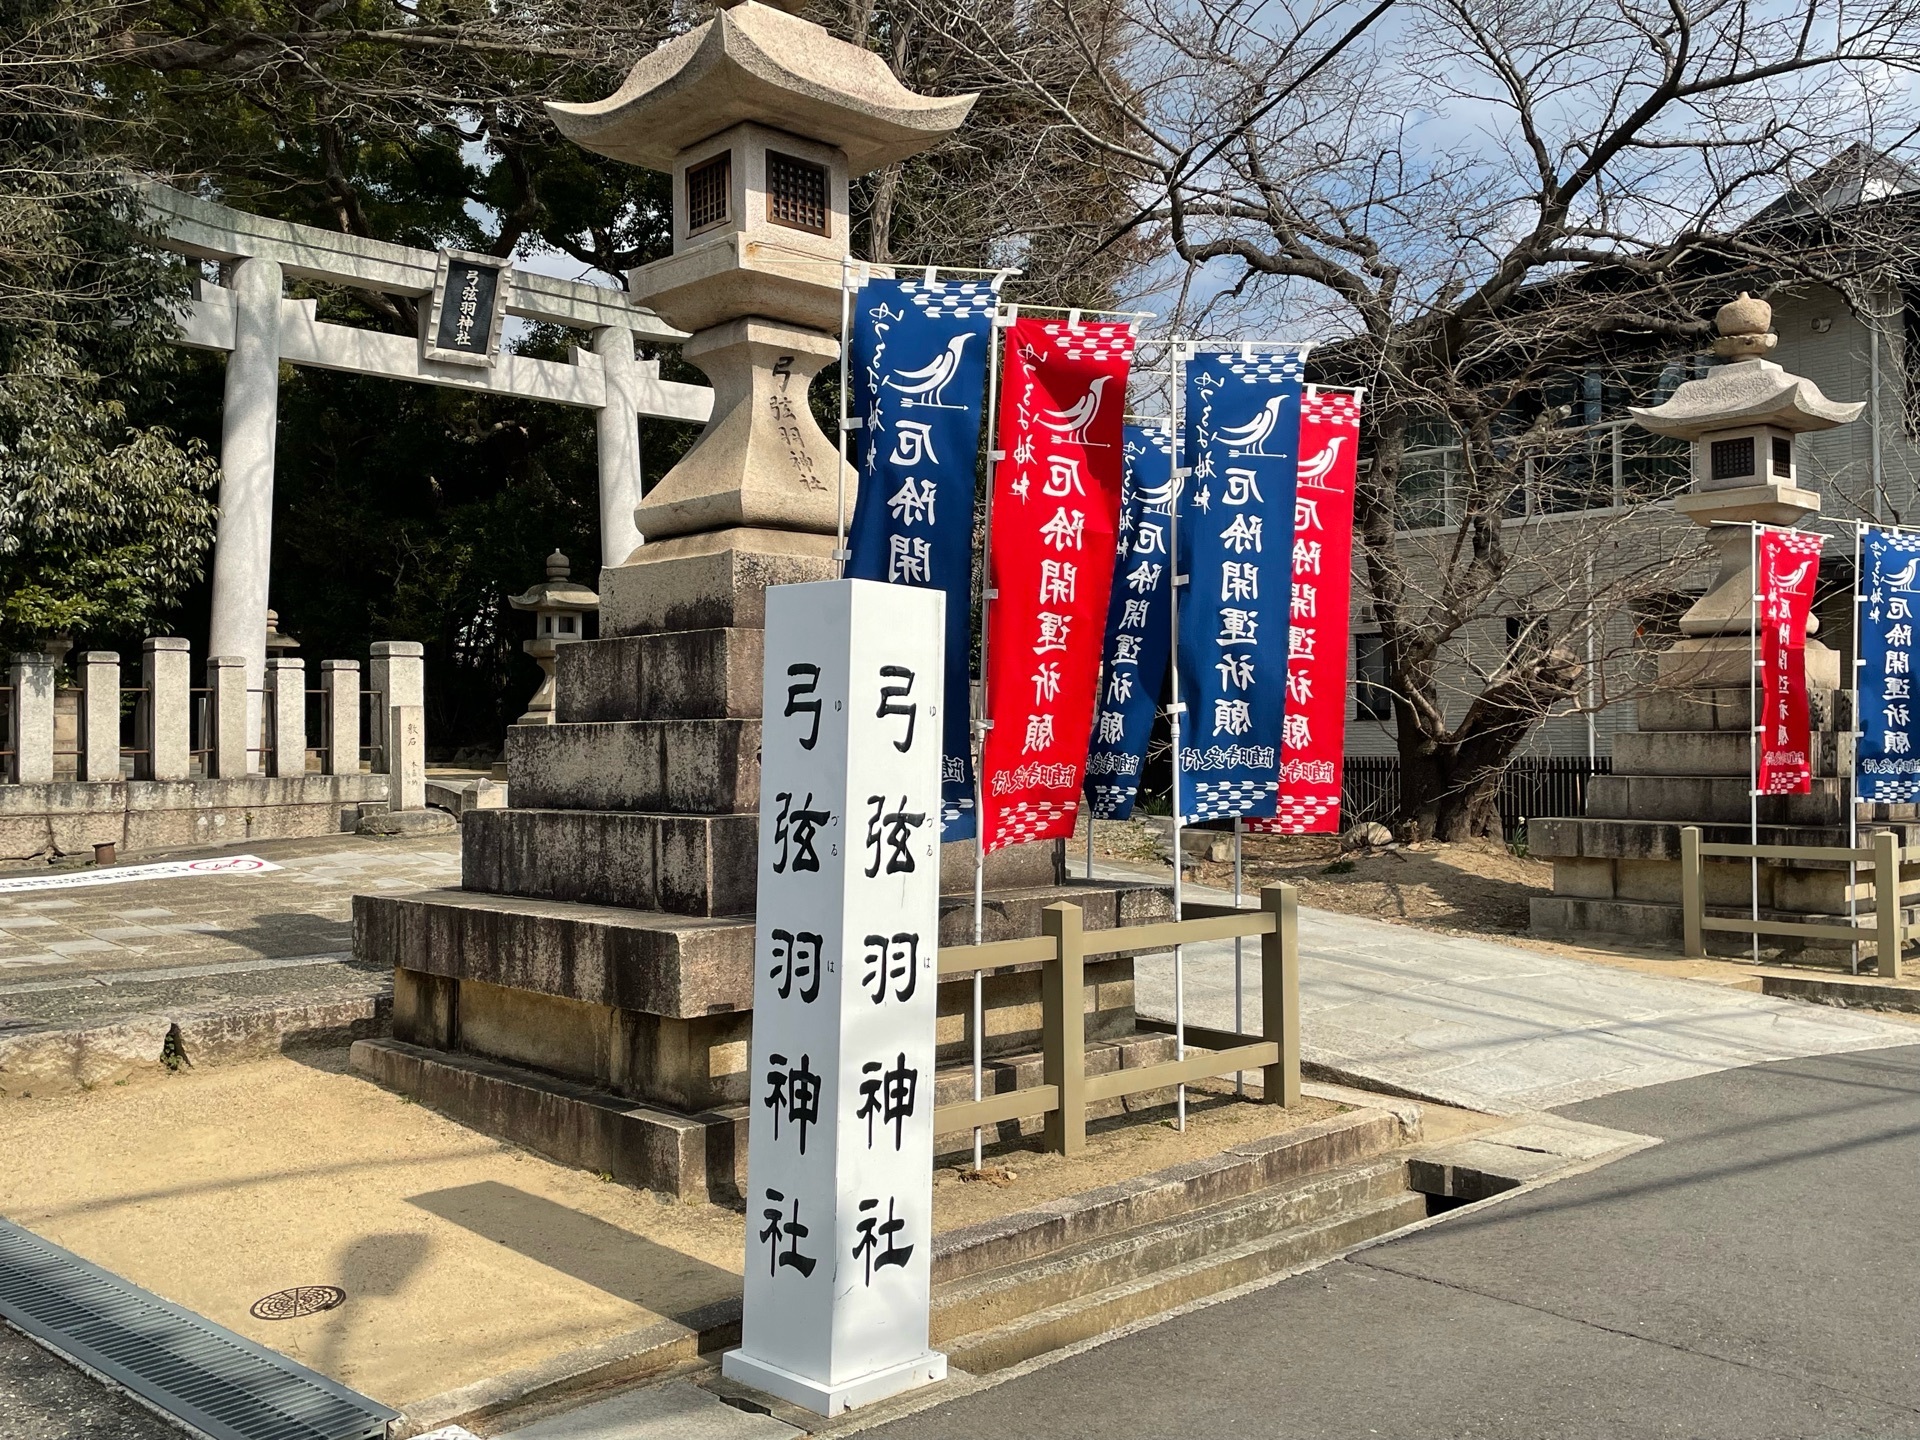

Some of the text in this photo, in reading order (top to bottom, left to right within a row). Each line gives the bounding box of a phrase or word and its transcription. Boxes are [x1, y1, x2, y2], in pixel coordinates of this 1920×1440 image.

[454, 269, 480, 346] 弓弦羽神社
[769, 355, 829, 493] 弓弦羽神社
[760, 663, 831, 1278] 弓弦羽神社
[852, 664, 926, 1288] 弓弦羽神社
